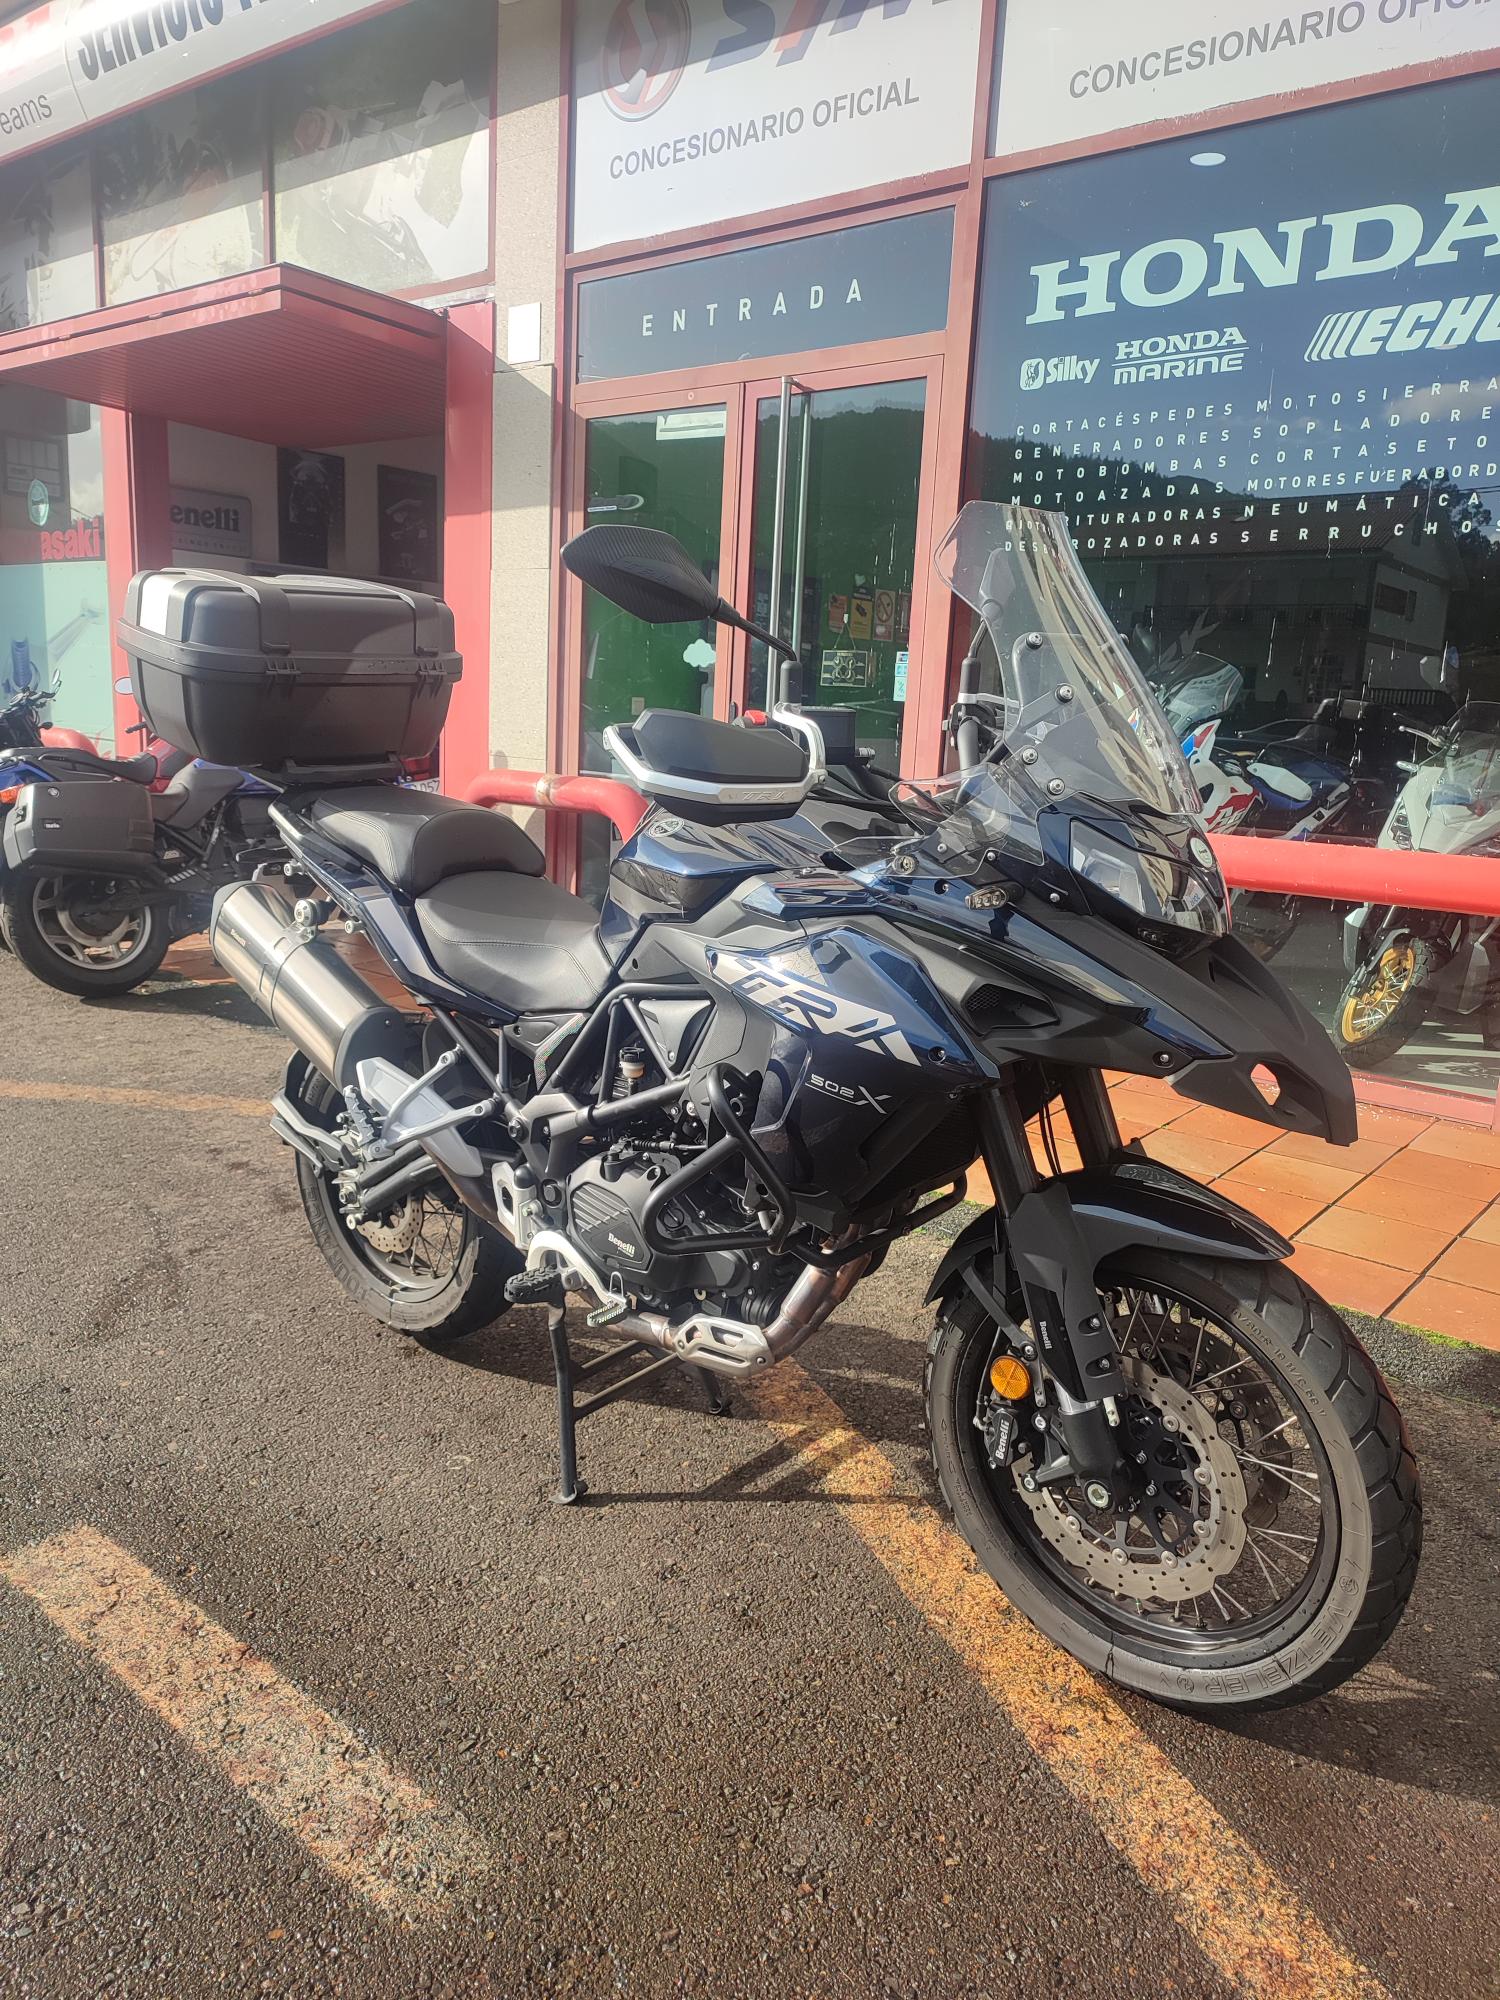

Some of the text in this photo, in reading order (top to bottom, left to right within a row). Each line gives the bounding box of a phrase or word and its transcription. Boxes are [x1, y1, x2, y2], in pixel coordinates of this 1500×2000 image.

[1068, 1, 1365, 99] CONCESIONARIO
[609, 77, 920, 180] CONCESIONARIO OFICIAL
[1025, 185, 1500, 326] HONDA
[641, 278, 863, 337] ENTRADA
[1115, 326, 1247, 360] HONDA
[1045, 355, 1101, 385] Silky
[1016, 402, 1234, 437] CORTACÉSPEDES
[1014, 429, 1230, 460] GENERADORES
[1012, 453, 1228, 484] MOTOBOMBAS
[1011, 481, 1225, 506] MOTOAZADAS
[607, 1232, 636, 1256] Benelli
[1039, 1320, 1053, 1350] Benelli
[994, 1419, 1011, 1461] Benelli
